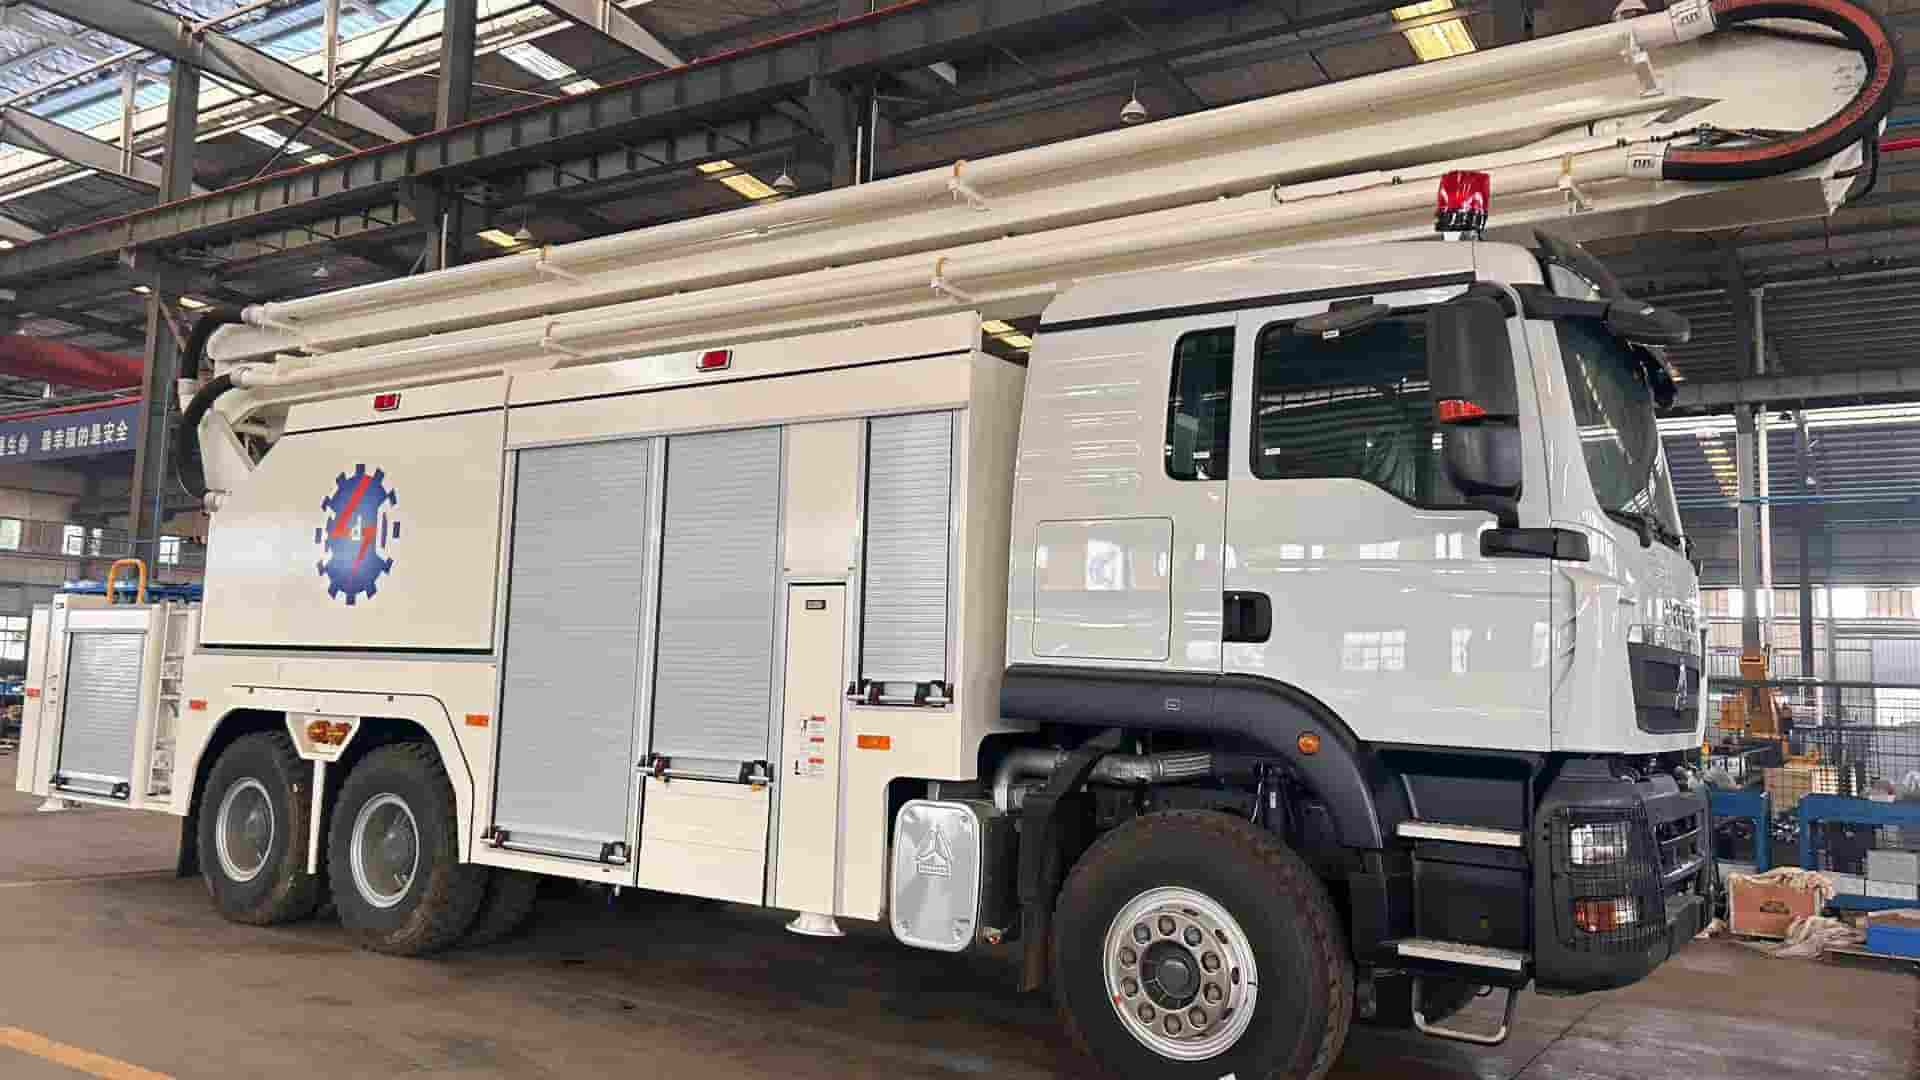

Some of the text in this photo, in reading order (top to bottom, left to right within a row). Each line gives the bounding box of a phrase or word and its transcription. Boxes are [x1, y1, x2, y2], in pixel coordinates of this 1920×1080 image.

[40, 418, 129, 451] 最幸福的是安全
